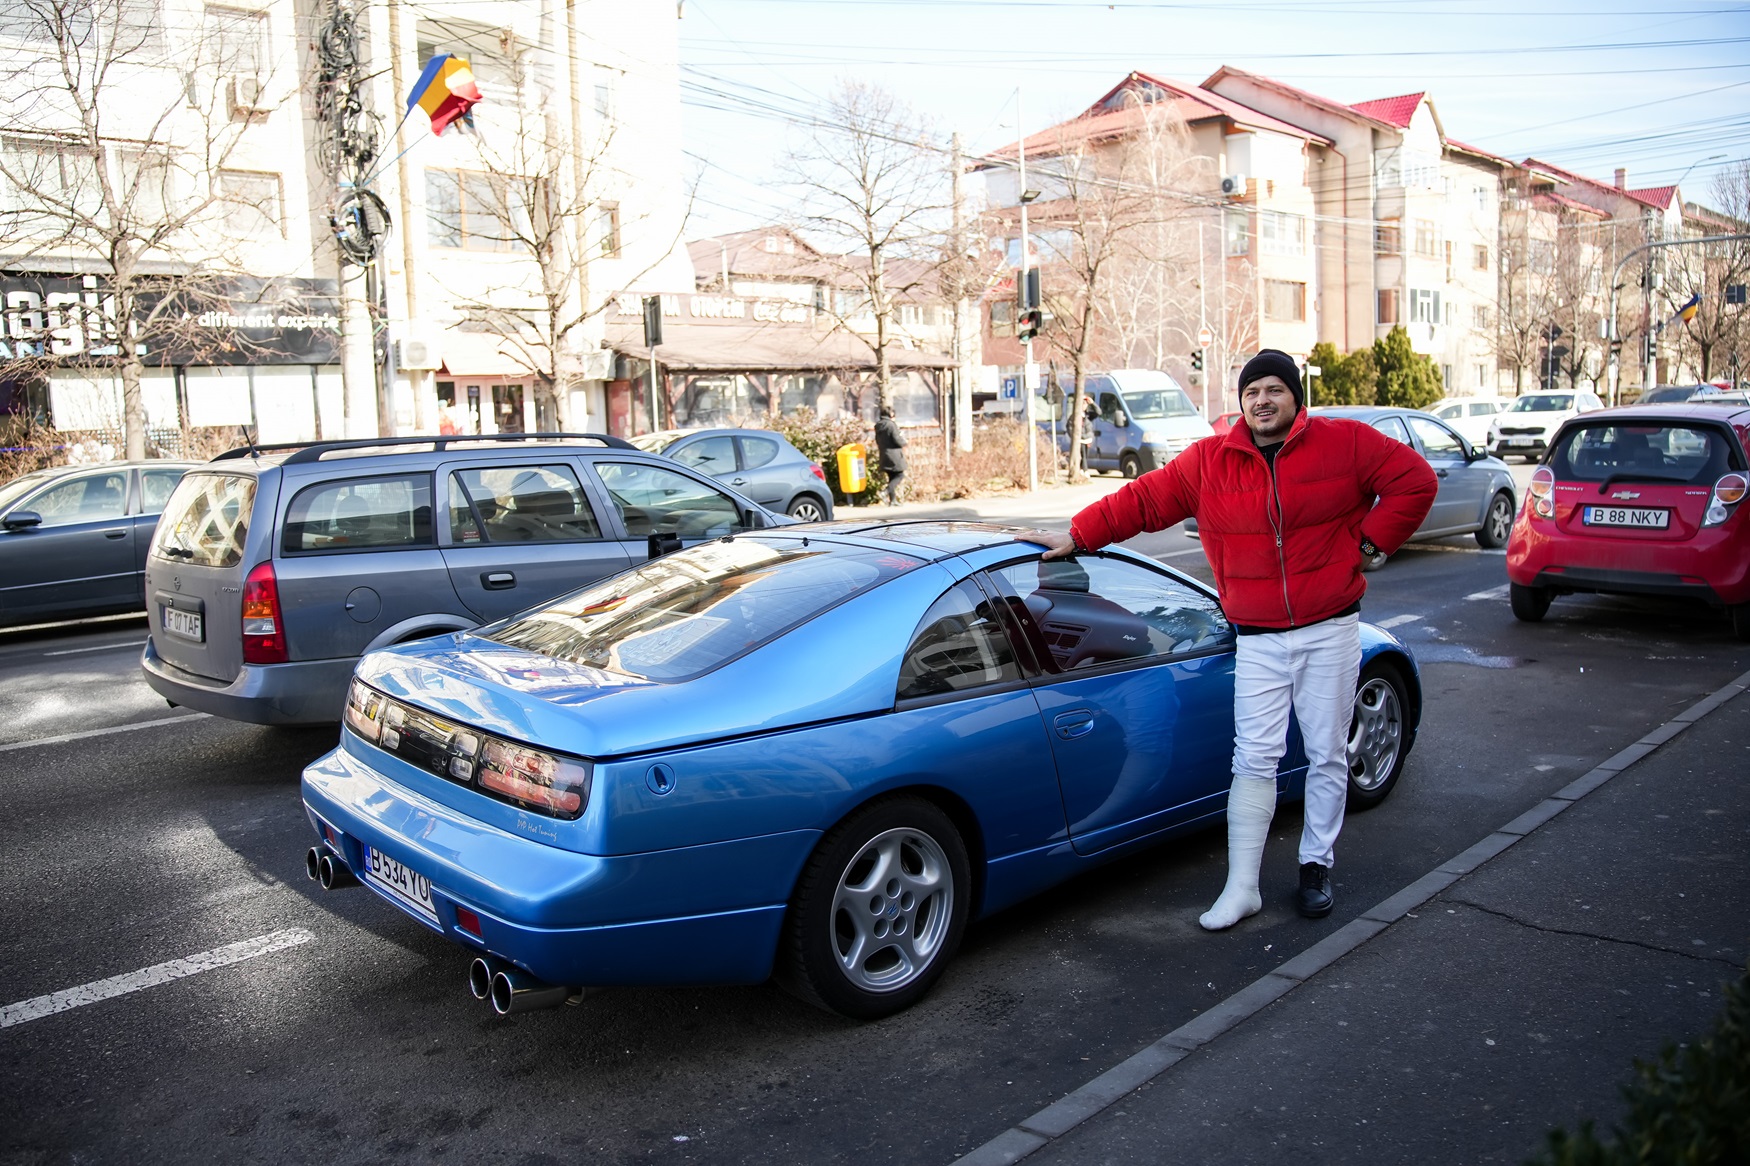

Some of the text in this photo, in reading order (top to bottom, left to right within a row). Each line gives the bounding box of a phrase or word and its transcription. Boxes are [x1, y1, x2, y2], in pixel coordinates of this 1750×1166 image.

[198, 311, 275, 327] different
[277, 312, 340, 331] experie
[1007, 380, 1015, 397] P
[1594, 509, 1663, 524] B 88 NKY
